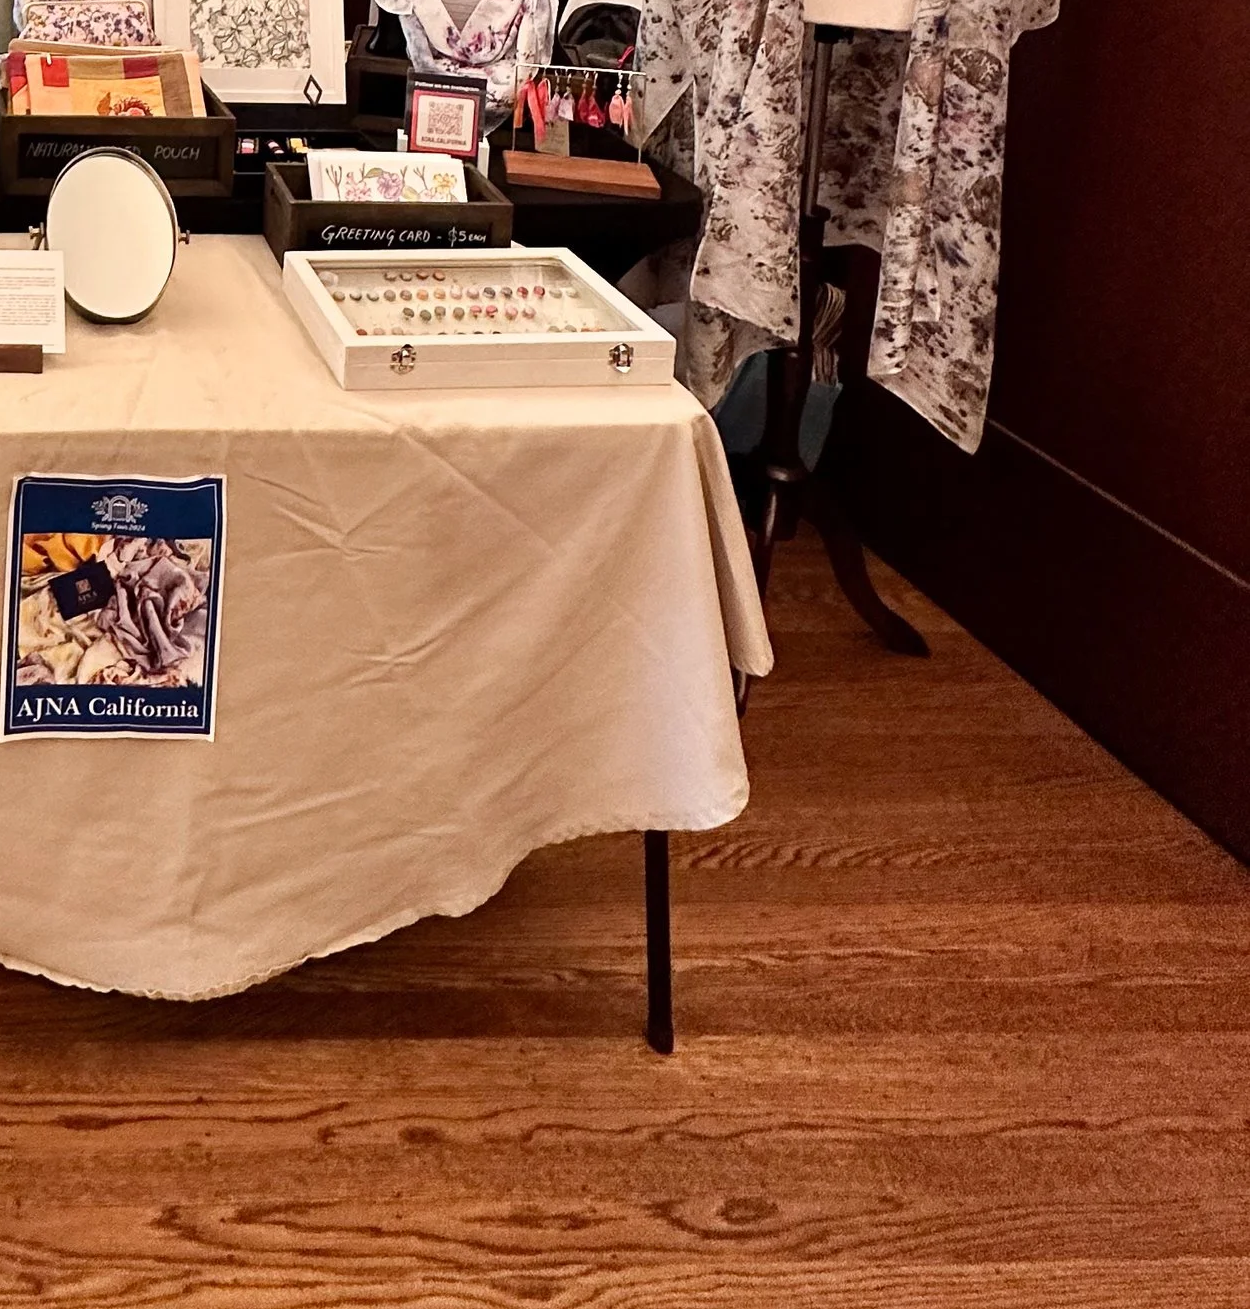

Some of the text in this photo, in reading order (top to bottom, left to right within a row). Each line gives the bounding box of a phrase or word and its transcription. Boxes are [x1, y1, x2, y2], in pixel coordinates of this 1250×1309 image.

[154, 144, 200, 161] POUCH
[321, 224, 397, 247] GREETING
[399, 229, 430, 242] CARD
[448, 226, 467, 248] $5
[16, 696, 199, 722] AJNA California
